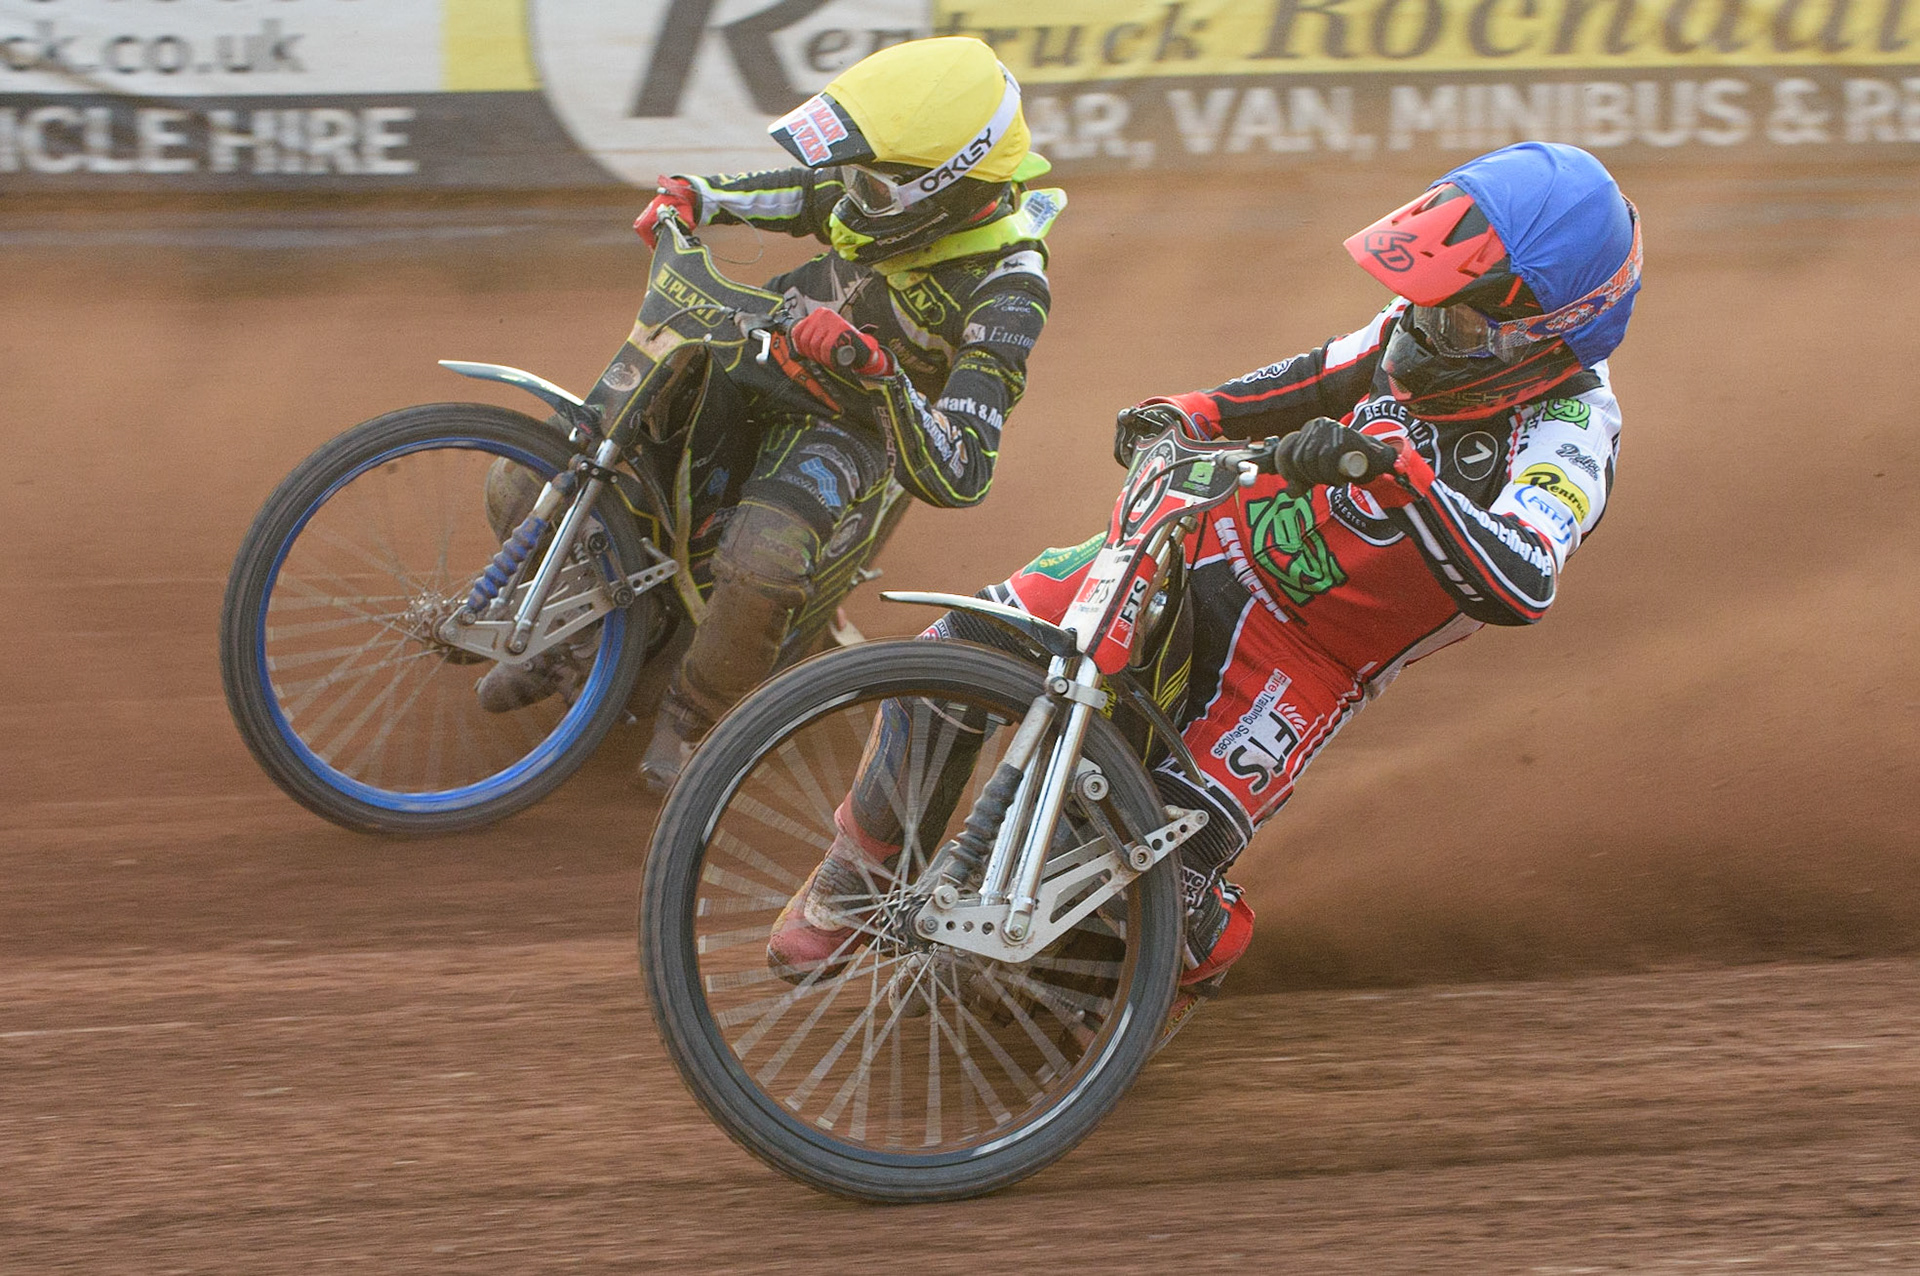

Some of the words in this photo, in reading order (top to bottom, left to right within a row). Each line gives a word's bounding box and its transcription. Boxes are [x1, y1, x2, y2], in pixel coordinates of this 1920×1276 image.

[207, 107, 418, 175] HIRE
[1388, 78, 1748, 151] MINIBUS
[1766, 77, 1830, 144] &
[919, 128, 992, 192] OAKLEY
[1363, 403, 1409, 421] BELLE
[1120, 579, 1148, 625] FTS
[1242, 692, 1276, 726] Training
[1267, 670, 1288, 693] Fire
[1229, 711, 1299, 793] FTS
